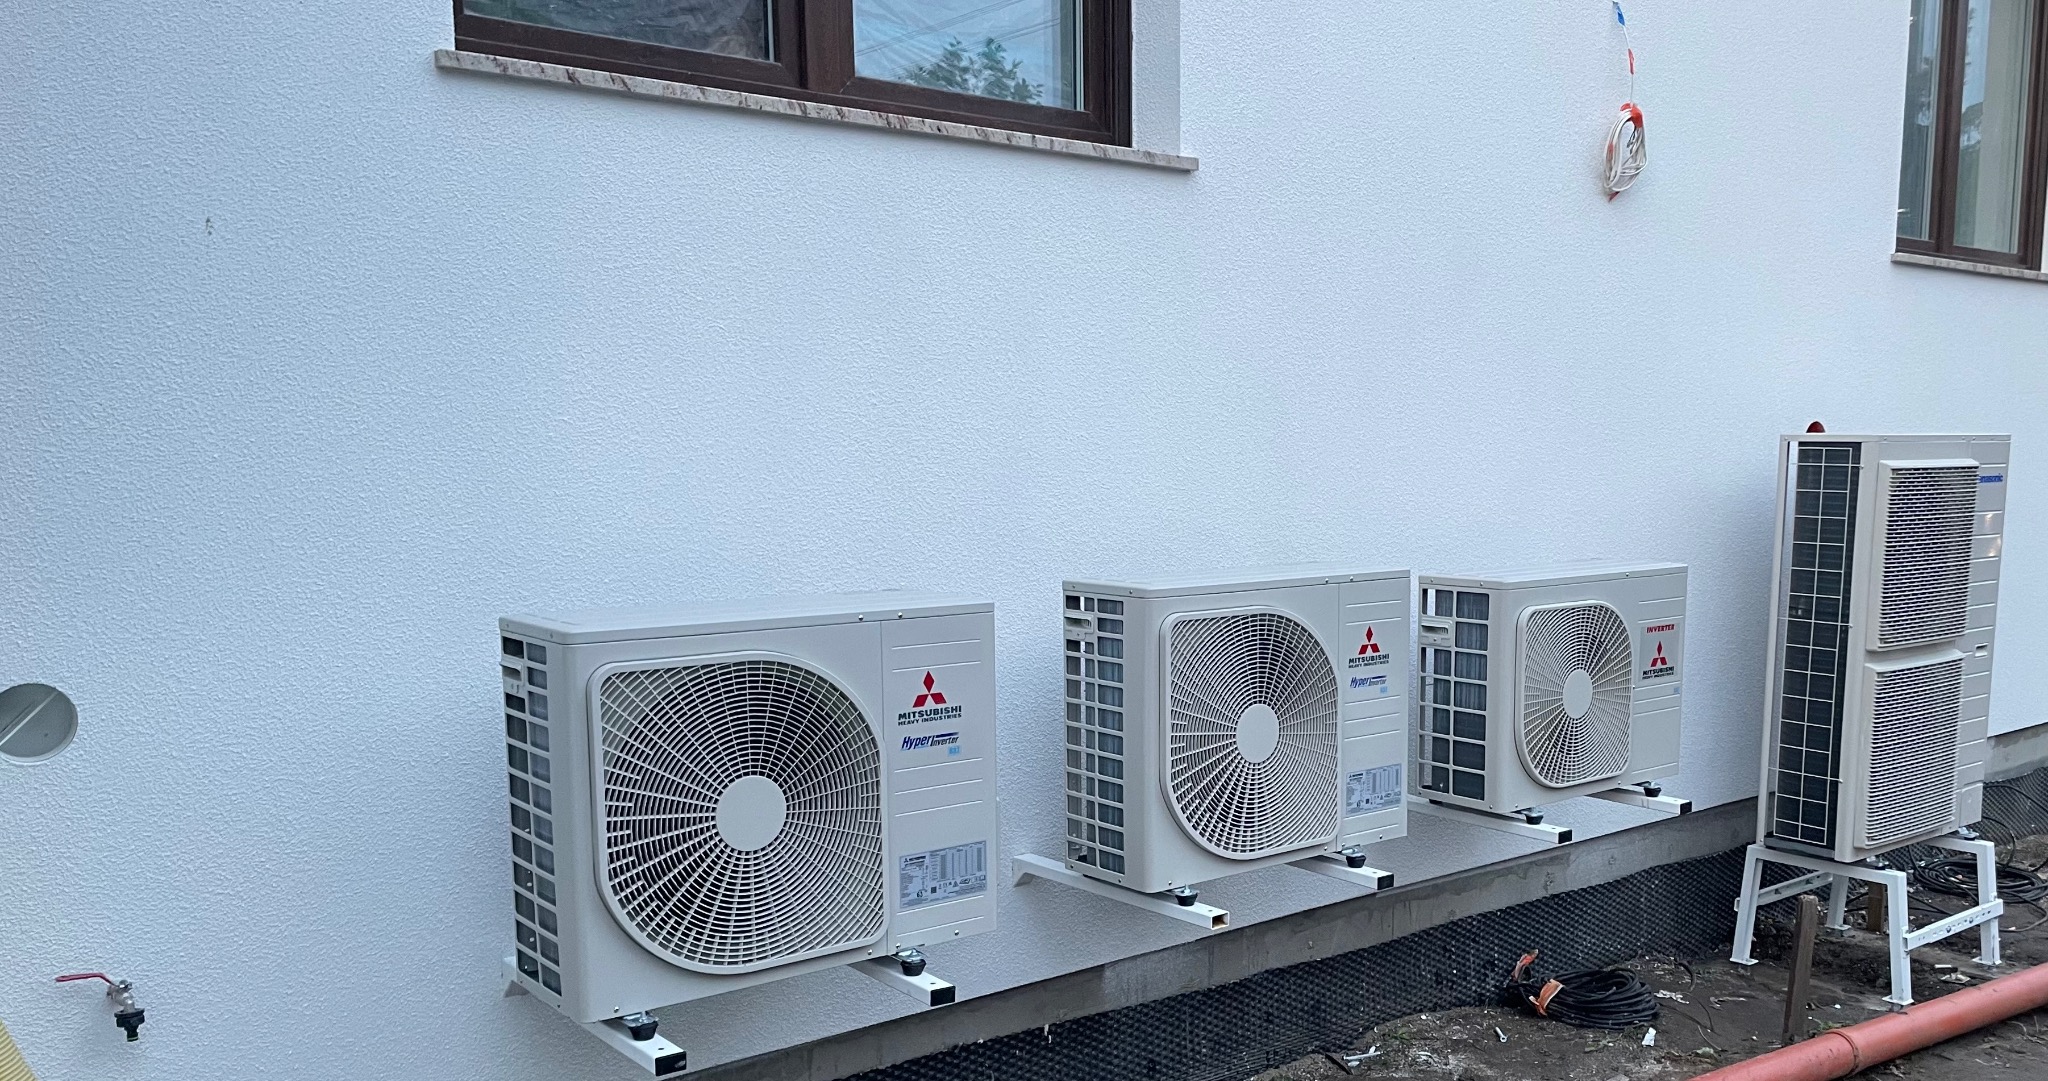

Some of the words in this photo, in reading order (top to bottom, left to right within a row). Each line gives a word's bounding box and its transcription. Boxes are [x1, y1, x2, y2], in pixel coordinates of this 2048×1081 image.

[1978, 473, 2004, 484] anasonic
[1646, 624, 1675, 634] INVERTER
[1348, 653, 1390, 665] MITSUBISHI
[1642, 666, 1675, 676] MITSUBISHI
[897, 705, 962, 721] MITSUBISHI
[897, 719, 920, 727] HEAVY
[921, 713, 962, 723] INDUSTRIES
[901, 735, 931, 751] Hyper
[929, 735, 959, 747] Inverter
